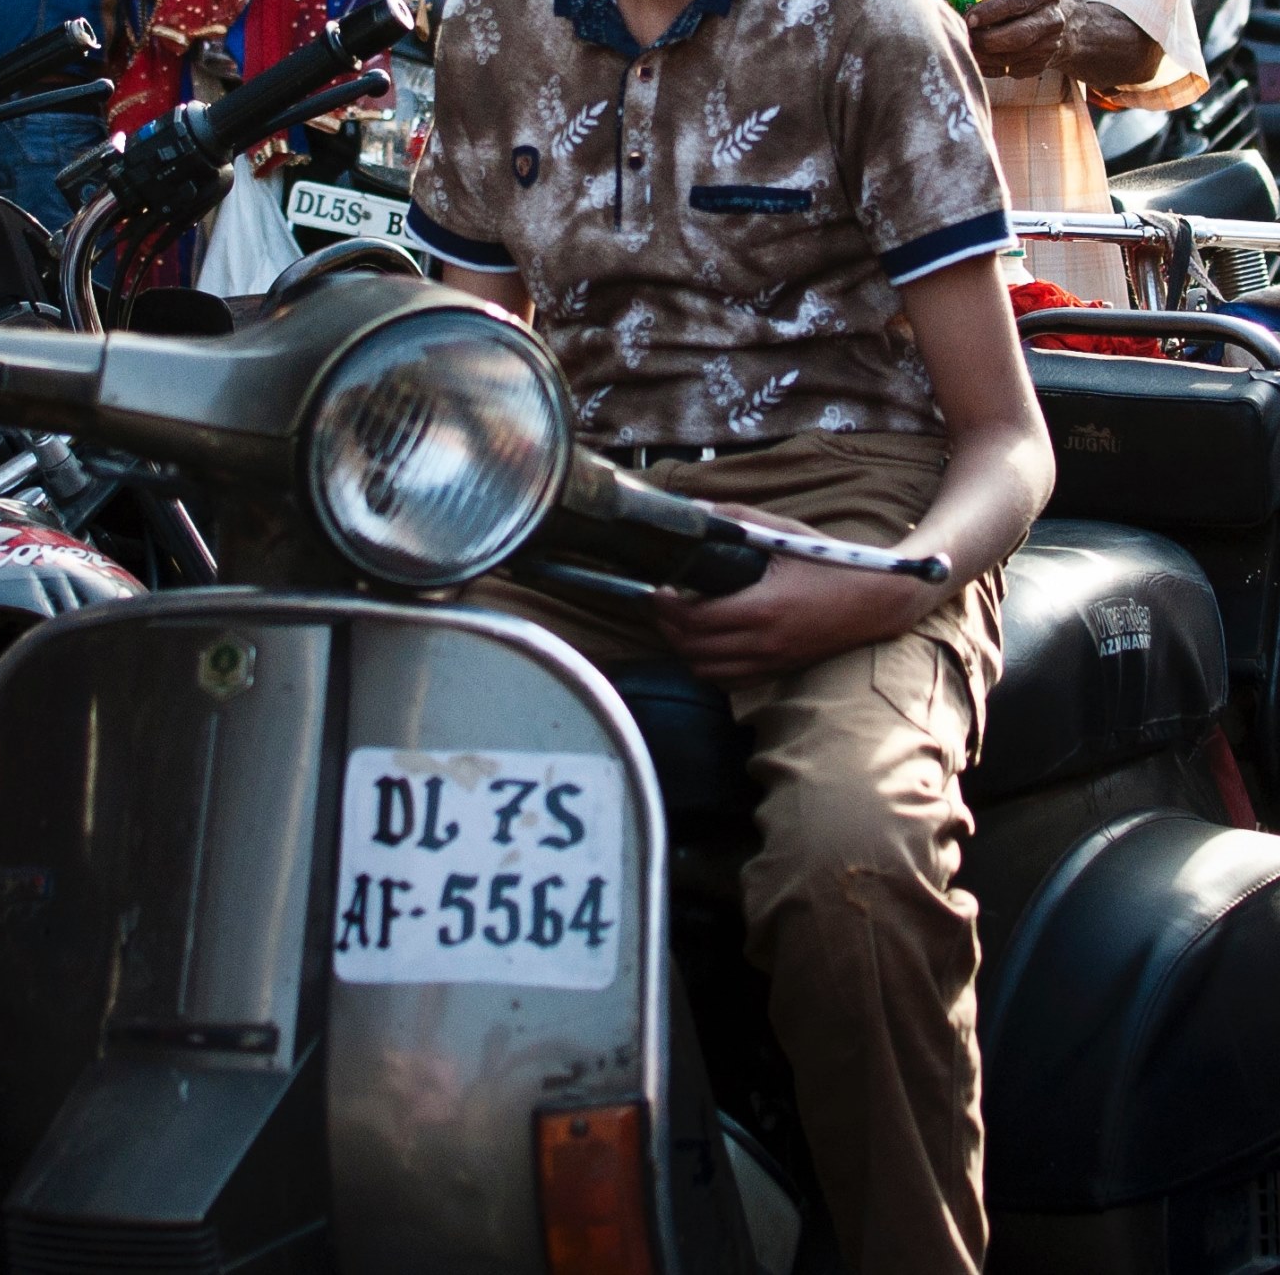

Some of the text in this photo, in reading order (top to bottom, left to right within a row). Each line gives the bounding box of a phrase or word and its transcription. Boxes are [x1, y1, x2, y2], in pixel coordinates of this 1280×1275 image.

[295, 188, 363, 229] DL5S
[1063, 435, 1122, 453] JUGNU
[372, 775, 587, 850] DL 7S
[334, 872, 613, 951] AF-5564
